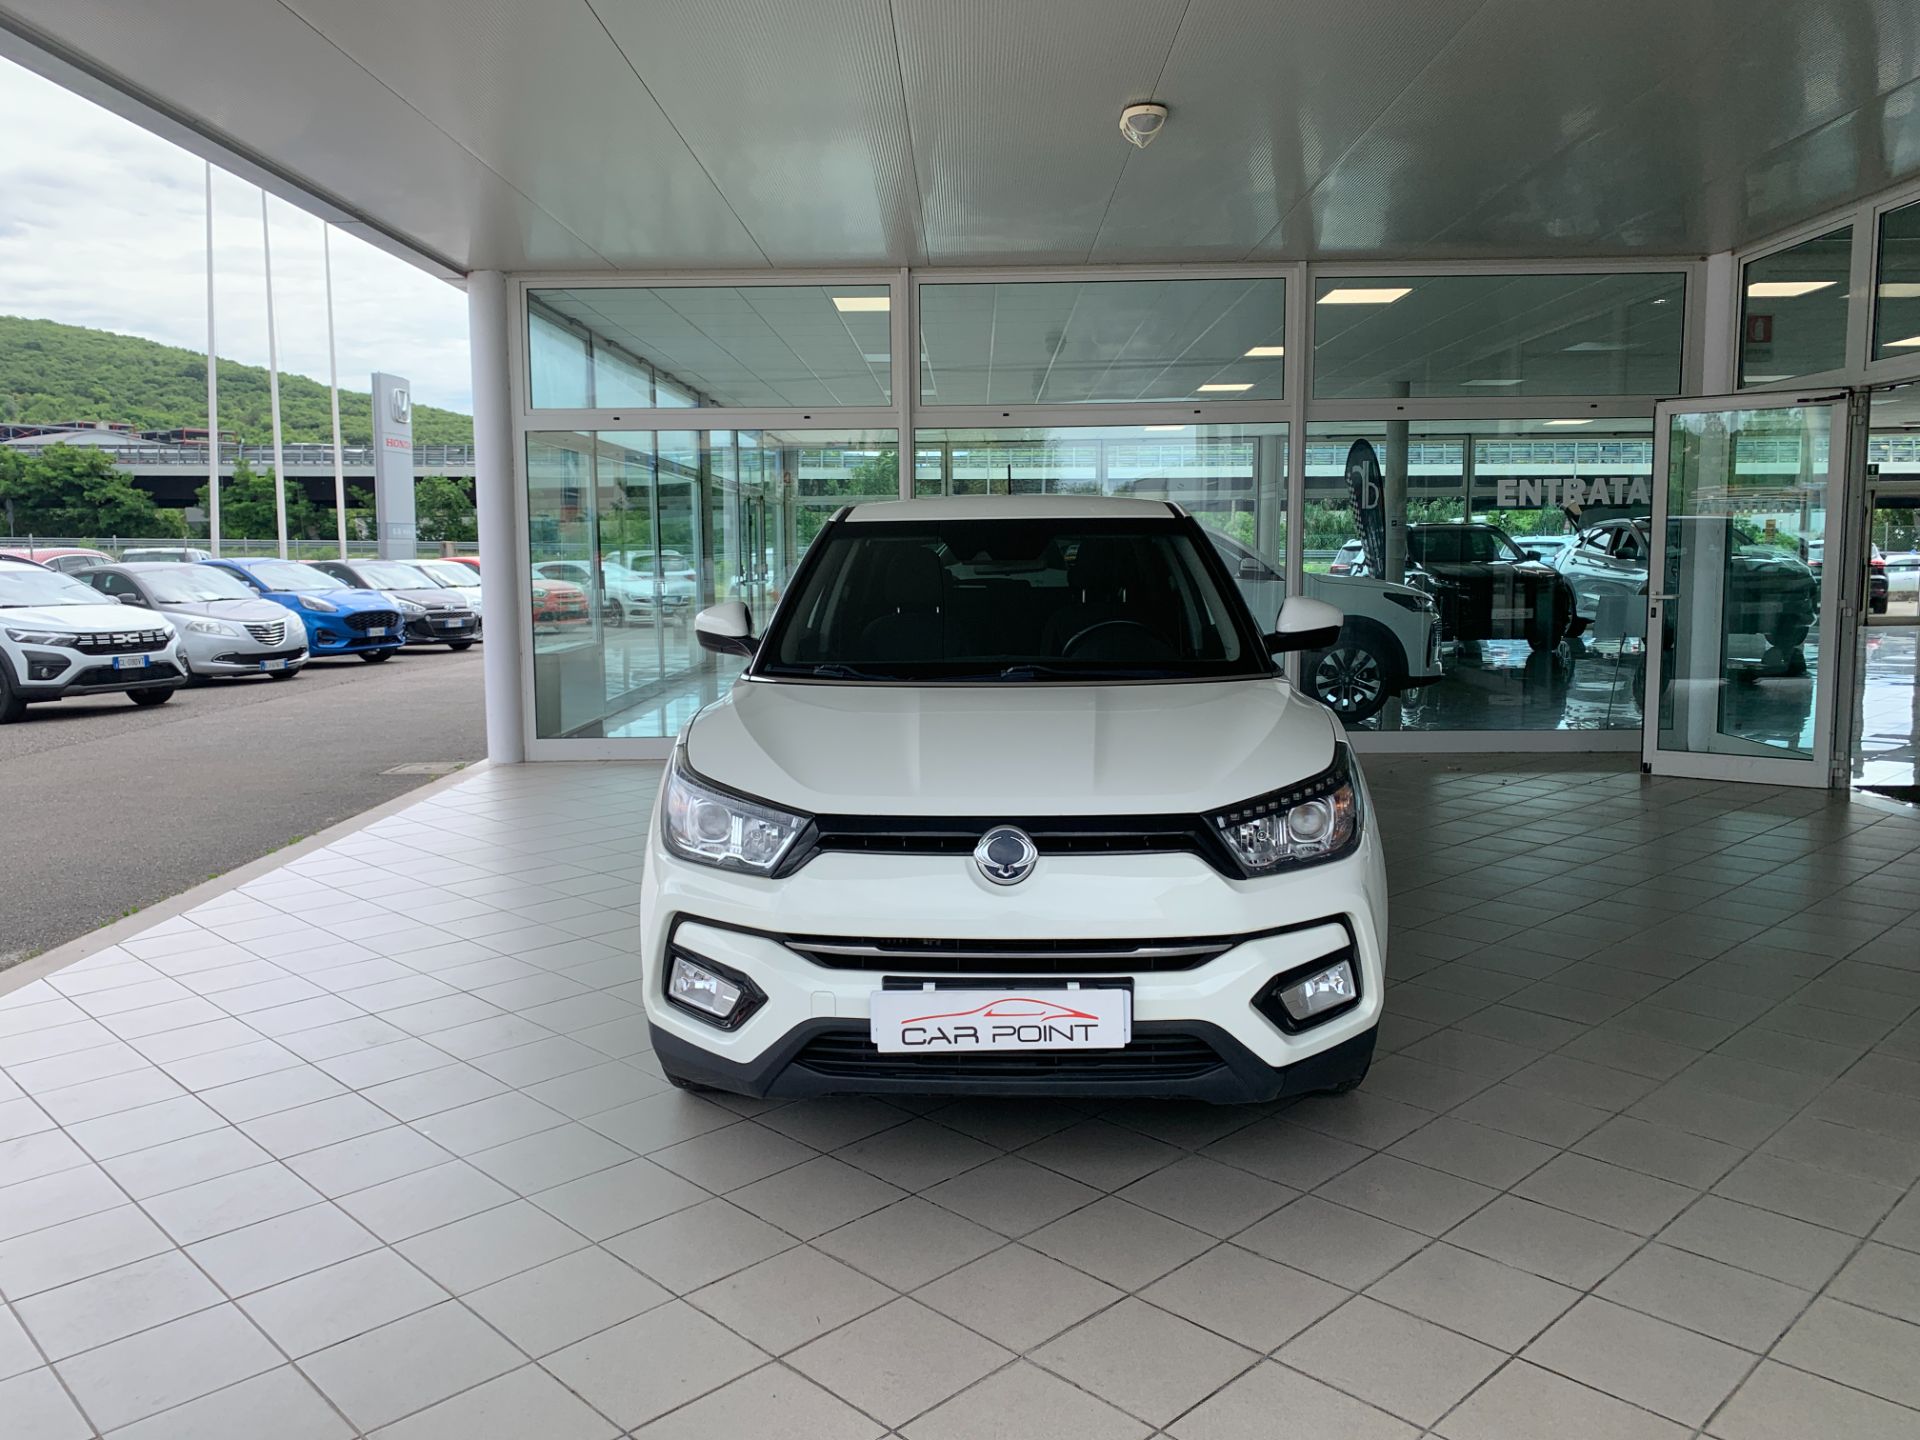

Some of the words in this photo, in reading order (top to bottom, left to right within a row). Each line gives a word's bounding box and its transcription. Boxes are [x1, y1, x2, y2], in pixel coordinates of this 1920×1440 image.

[1497, 477, 1650, 507] ENTRATA
[901, 1026, 980, 1046] CAR
[992, 1024, 1099, 1043] POINT
